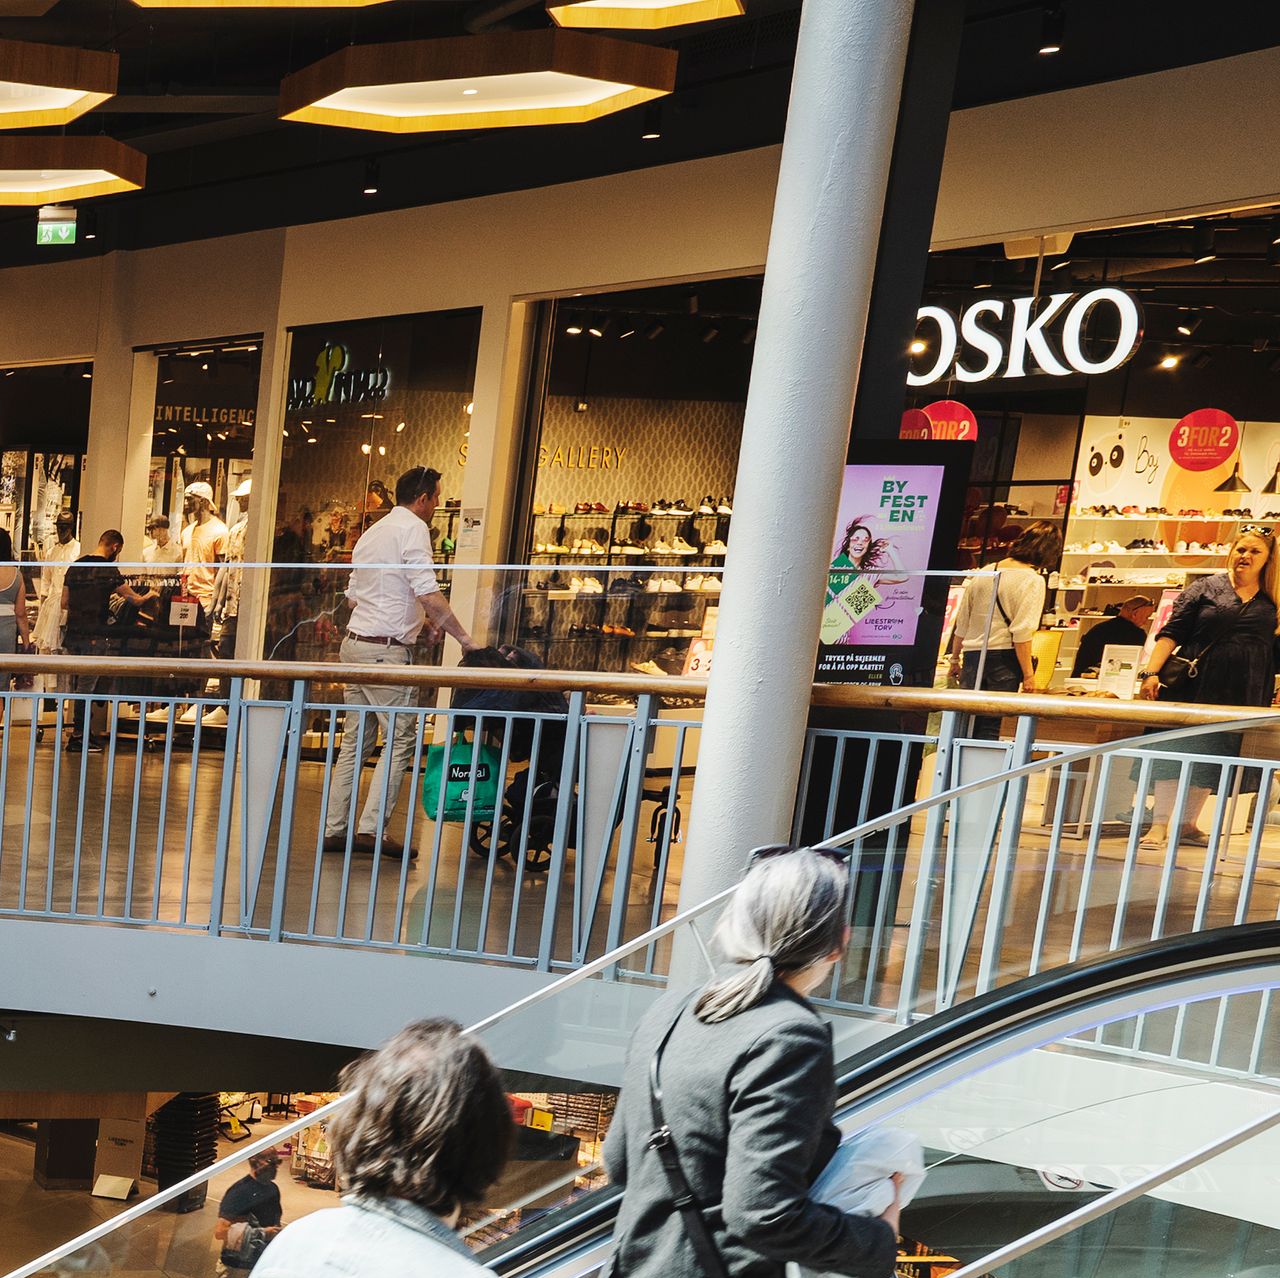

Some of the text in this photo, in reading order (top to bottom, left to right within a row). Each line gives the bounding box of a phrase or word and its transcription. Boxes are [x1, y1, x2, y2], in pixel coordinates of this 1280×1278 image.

[906, 288, 1139, 387] OSKO
[155, 405, 254, 423] INTELLIGENC
[538, 445, 627, 469] GALLERY
[882, 480, 908, 493] BY
[880, 495, 928, 508] FEST
[888, 509, 915, 523] EN
[691, 658, 700, 671] 3
[451, 766, 486, 778] Noral
